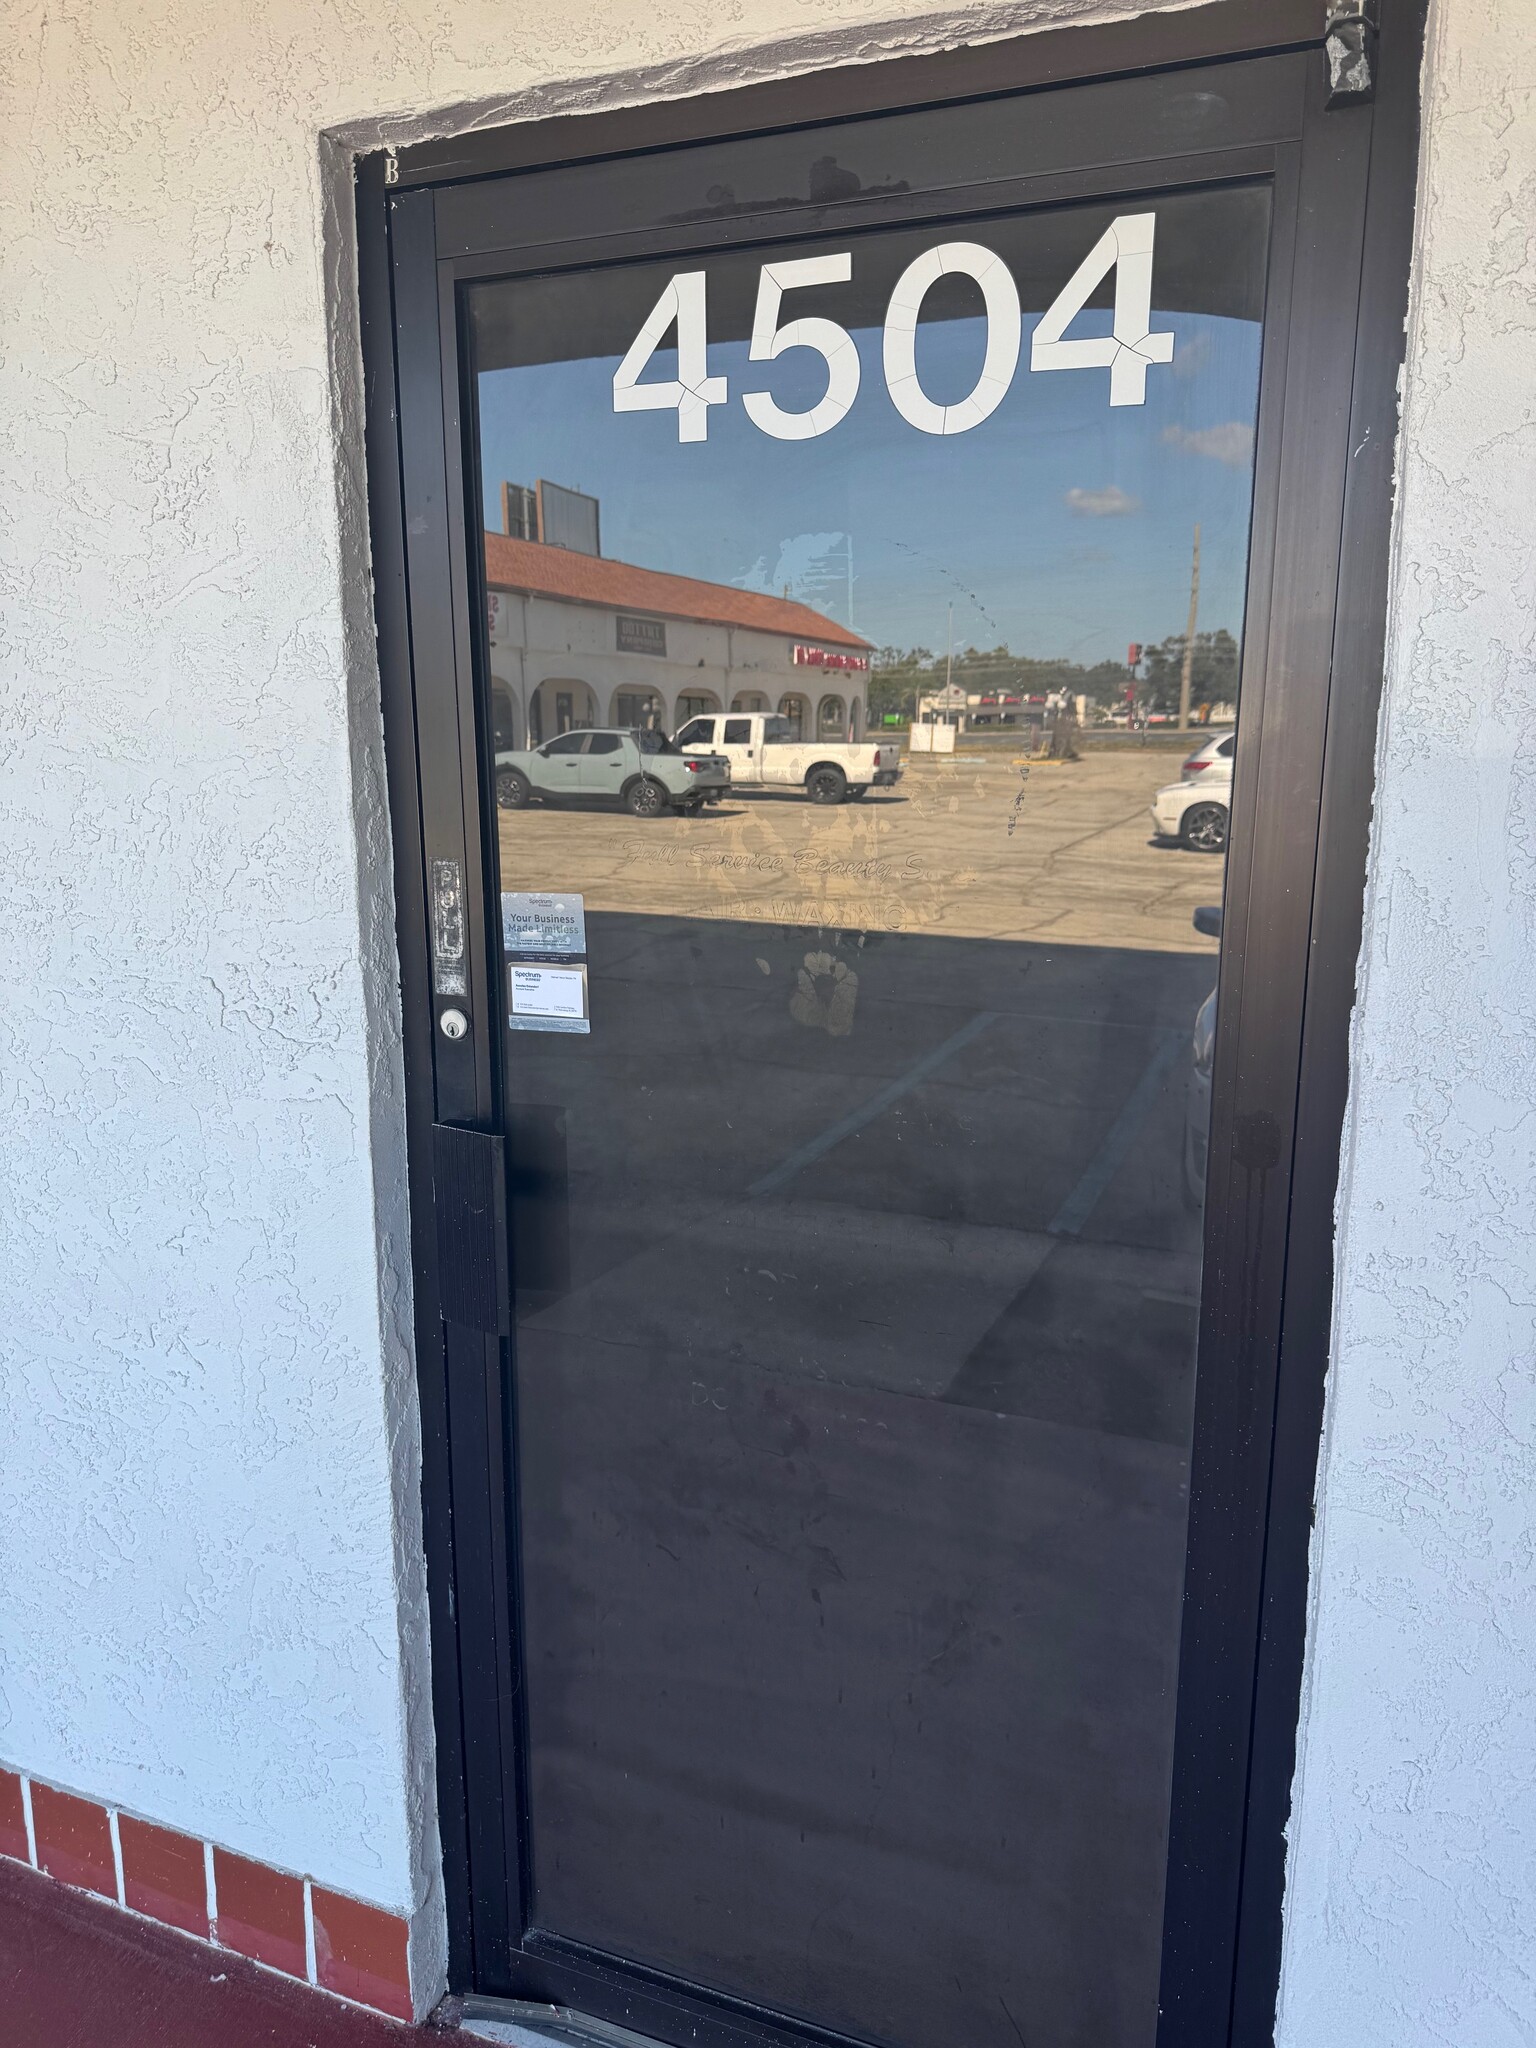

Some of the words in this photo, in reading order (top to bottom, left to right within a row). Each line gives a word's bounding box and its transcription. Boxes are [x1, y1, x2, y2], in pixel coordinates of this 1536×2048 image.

[384, 158, 400, 184] B
[612, 212, 1175, 443] 4504
[686, 843, 784, 873] Service
[793, 847, 892, 882] Beauty
[510, 913, 532, 923] Your
[534, 914, 575, 924] Business
[771, 897, 908, 932] WAXING
[508, 923, 534, 933] Made
[536, 924, 579, 934] Limitless
[514, 970, 542, 978] Spectrum
